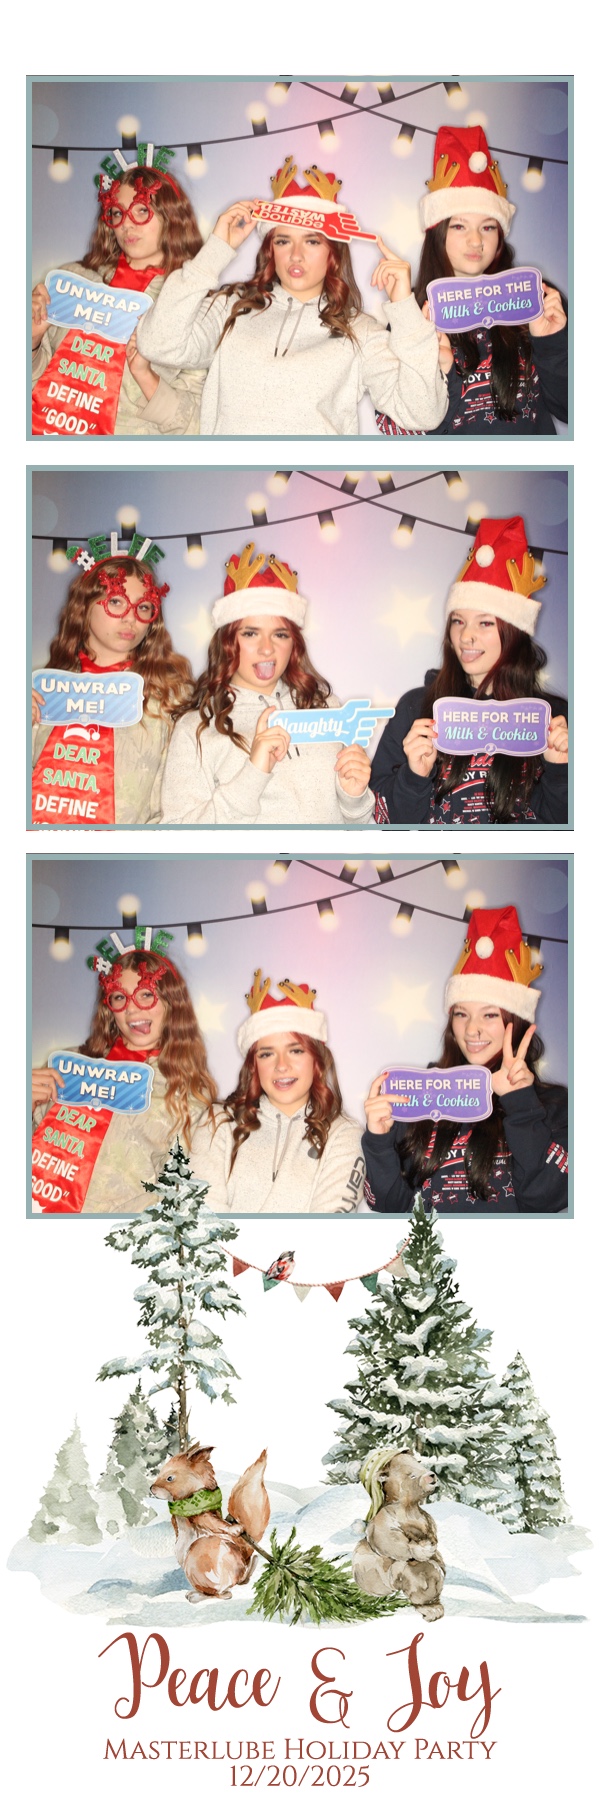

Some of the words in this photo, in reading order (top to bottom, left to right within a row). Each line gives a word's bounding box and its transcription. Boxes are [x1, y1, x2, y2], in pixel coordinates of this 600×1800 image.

[259, 210, 324, 229] eggnog
[260, 203, 326, 223] WASTED
[55, 278, 141, 314] UNWRAP
[437, 288, 472, 303] HERE
[475, 286, 502, 300] FOR
[505, 280, 532, 294] THE
[73, 303, 112, 327] ME!
[441, 303, 470, 320] Milk
[473, 302, 484, 315] &
[487, 297, 532, 315] Cookies
[70, 335, 114, 363] DEAR
[58, 358, 107, 391] SANTA,
[46, 381, 103, 414] DEFINE
[40, 678, 131, 695] UNWRAP
[66, 698, 105, 714] ME!
[443, 711, 478, 723] HERE
[482, 711, 509, 723] FOR
[513, 712, 540, 724] THE
[273, 717, 349, 738] Naughty
[444, 726, 473, 740] Milk
[477, 726, 488, 740] &
[492, 727, 538, 741] Cookies
[53, 743, 101, 766] DEAR
[43, 768, 100, 794] SANTA,
[35, 794, 99, 819] DEFINE
[58, 1059, 142, 1084] UNWRAP
[79, 1081, 116, 1100] ME!
[390, 1079, 422, 1090] HERE
[425, 1079, 452, 1090] FOR
[455, 1078, 481, 1089] THE
[422, 1093, 433, 1107] &
[436, 1093, 480, 1107] Cookies
[56, 1106, 97, 1133] DEAR
[43, 1126, 85, 1160] SANTA,
[32, 1149, 79, 1182] DEFINE
